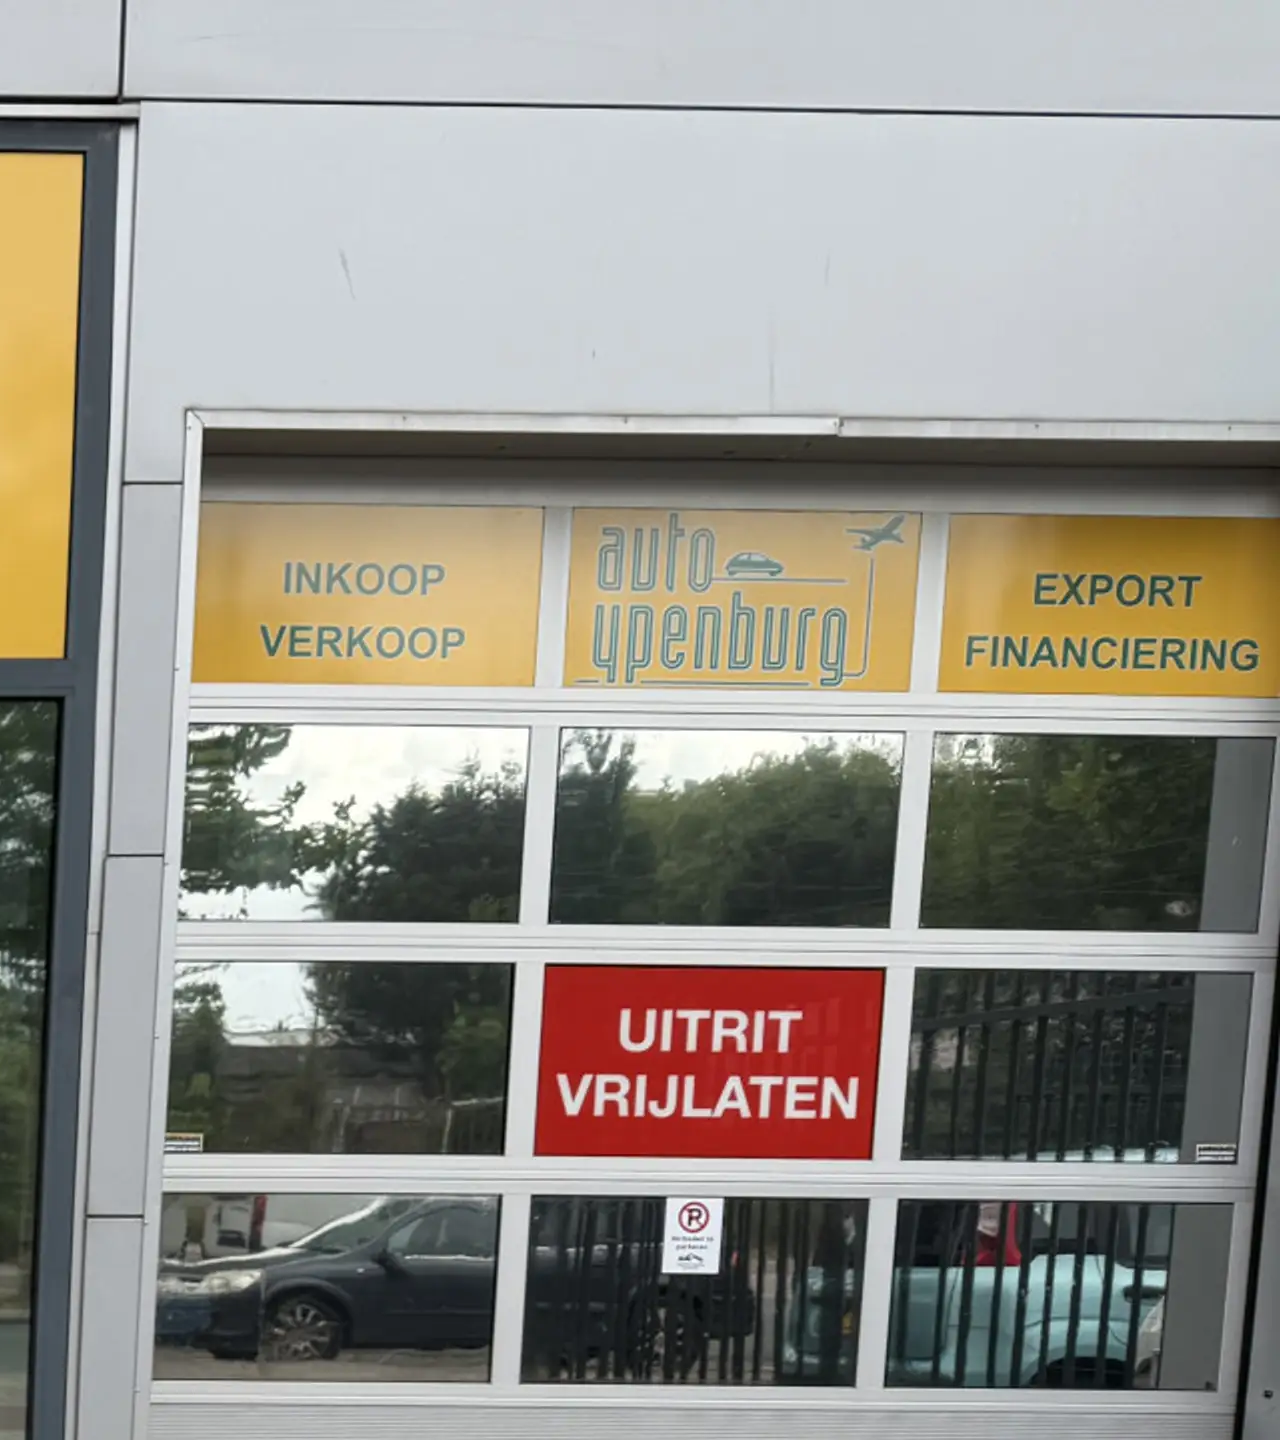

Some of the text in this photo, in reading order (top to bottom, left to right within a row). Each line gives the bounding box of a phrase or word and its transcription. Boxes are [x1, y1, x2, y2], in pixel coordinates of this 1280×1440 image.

[596, 512, 715, 592] auto
[283, 560, 446, 597] INKOOP
[1033, 572, 1203, 608] EXPORT
[260, 624, 466, 661] VERKOOP
[591, 592, 848, 688] ypenburg
[963, 635, 1261, 672] FINANCIERING
[619, 1007, 803, 1053] UITRIT
[556, 1073, 860, 1120] VRIJLATEN
